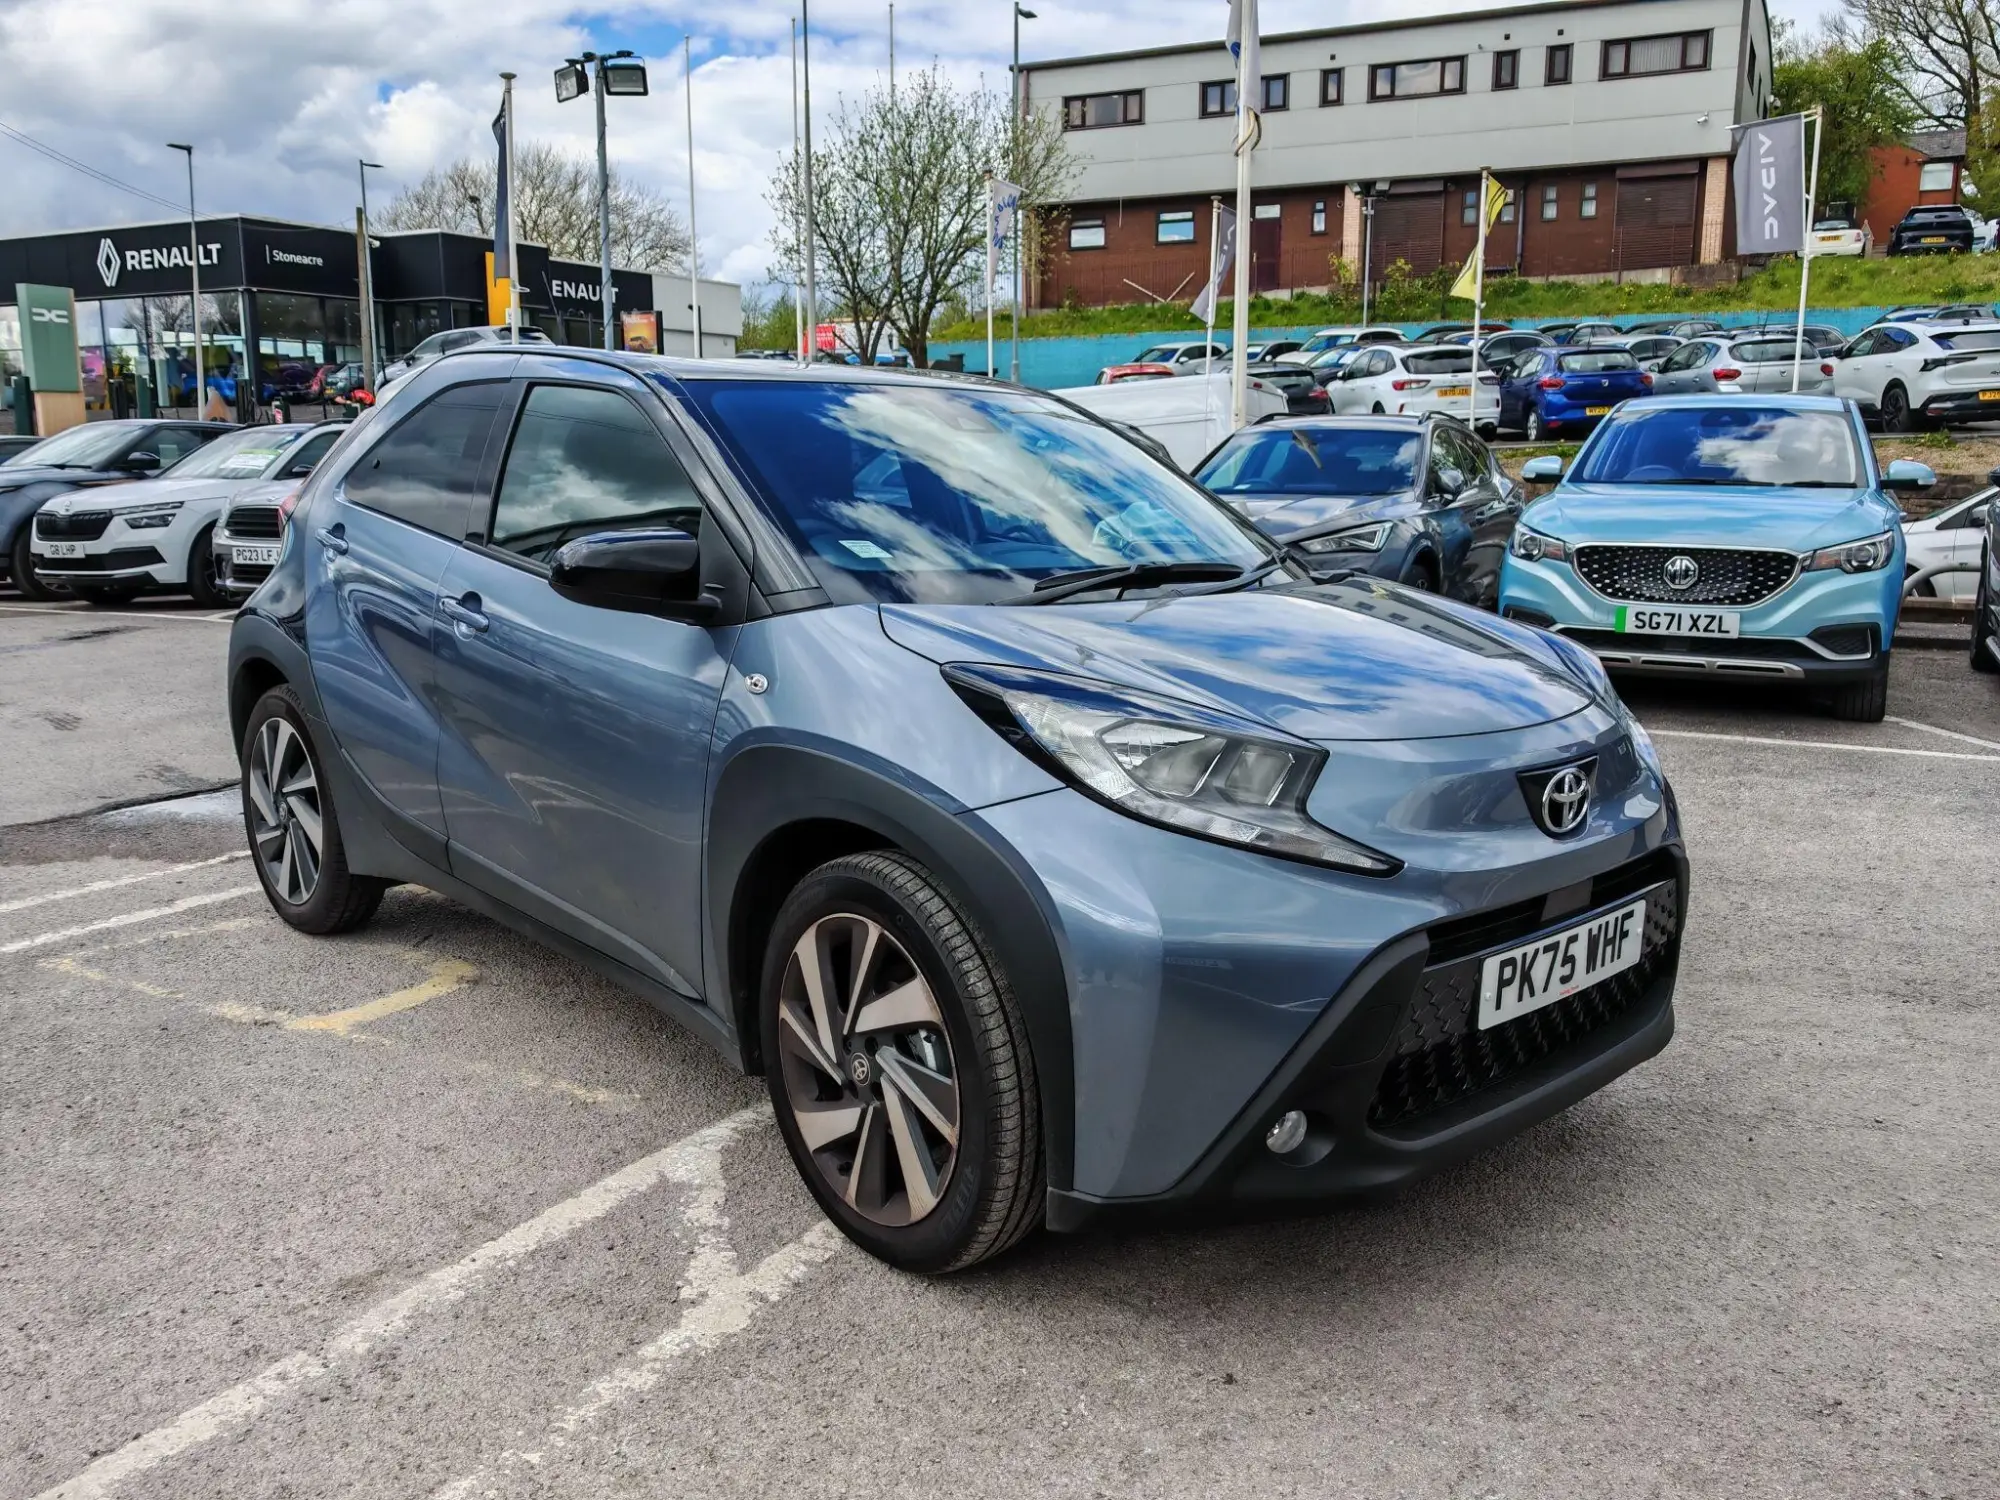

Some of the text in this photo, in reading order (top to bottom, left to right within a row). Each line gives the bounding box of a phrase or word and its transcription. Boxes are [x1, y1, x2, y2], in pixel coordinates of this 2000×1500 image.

[125, 243, 222, 271] RENAULT
[272, 249, 324, 267] Stoneacre
[552, 280, 619, 304] ENAUT
[236, 549, 259, 561] PG23
[1666, 558, 1696, 586] MG
[1633, 610, 1731, 635] SG71 XZL
[1495, 908, 1636, 1012] PK75 WHF
